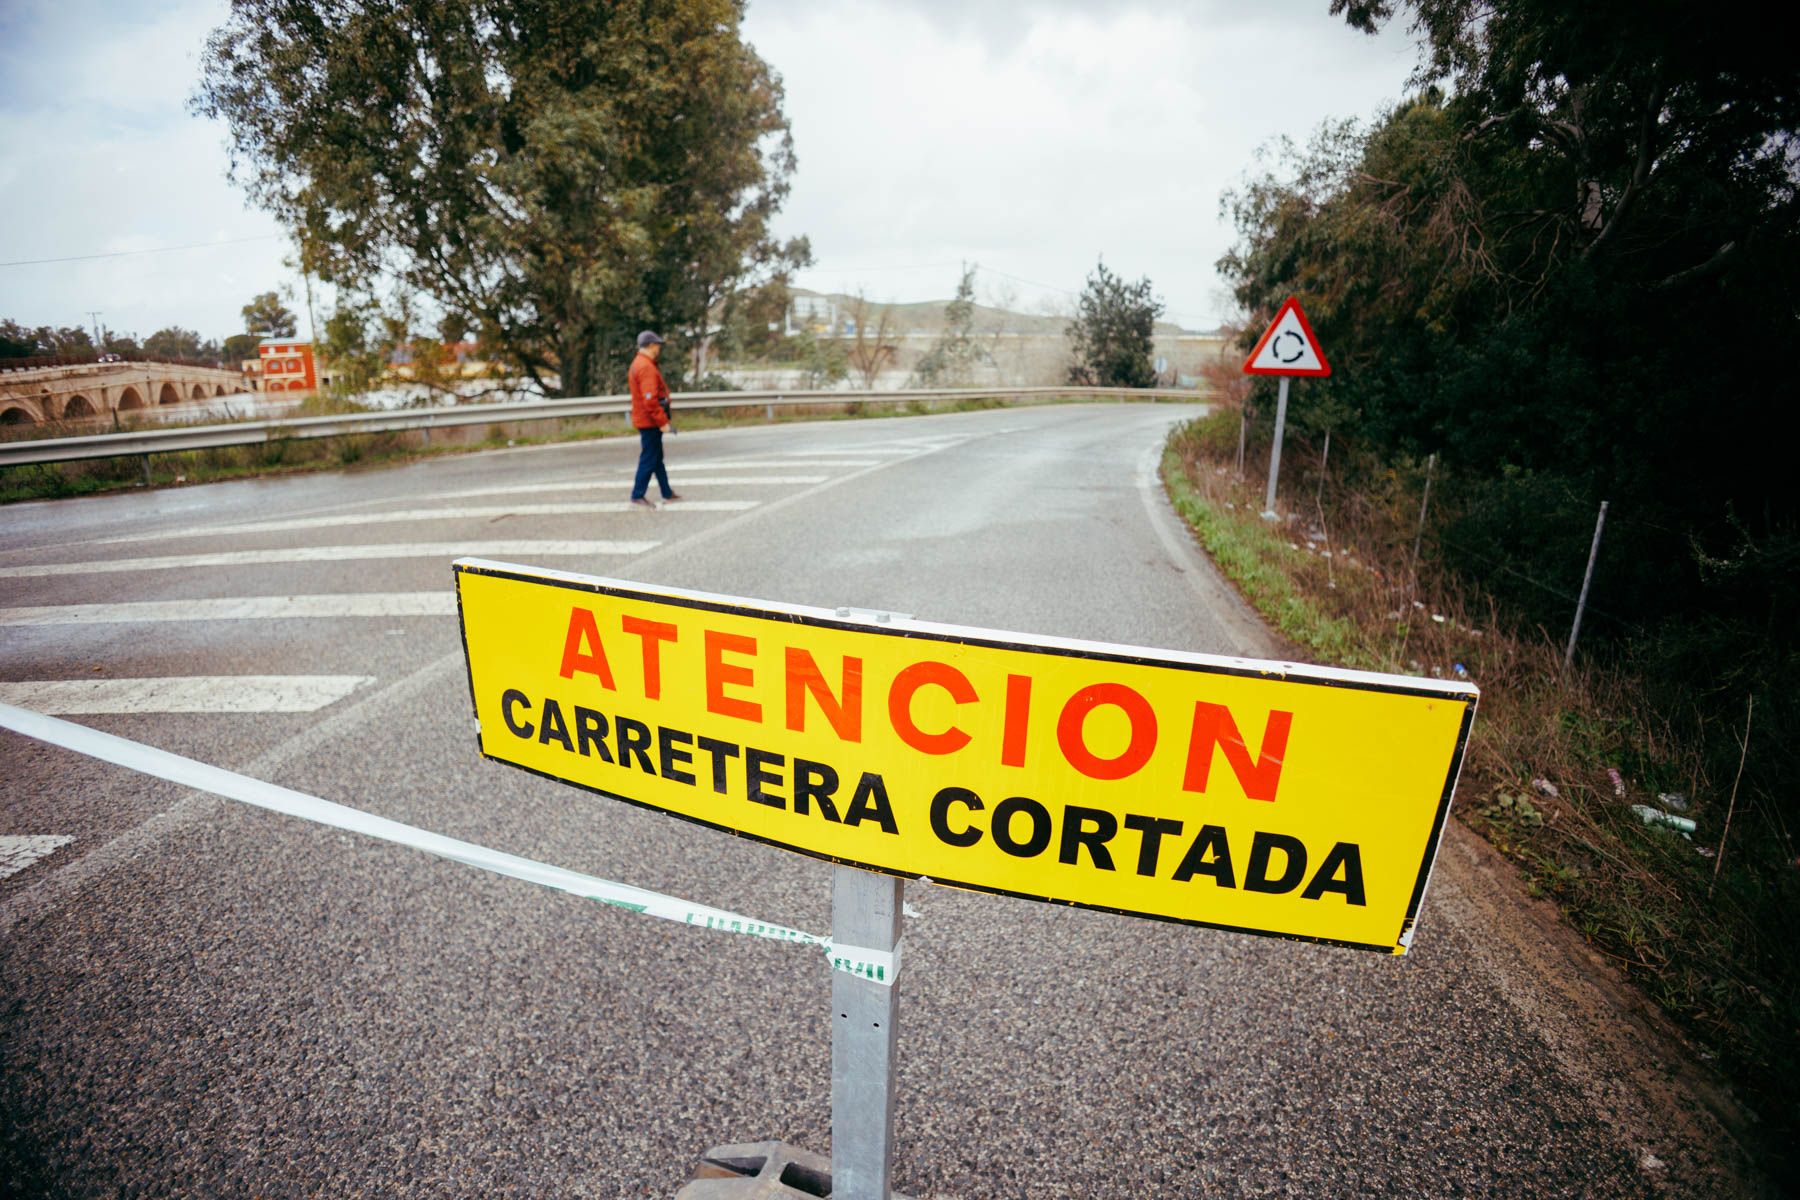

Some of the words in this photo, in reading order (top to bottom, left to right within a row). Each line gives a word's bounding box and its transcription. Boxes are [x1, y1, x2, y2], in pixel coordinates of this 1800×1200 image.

[502, 689, 899, 835] CARRETERA
[930, 787, 1367, 907] CORTADA
[560, 606, 1294, 803] ATENCION
